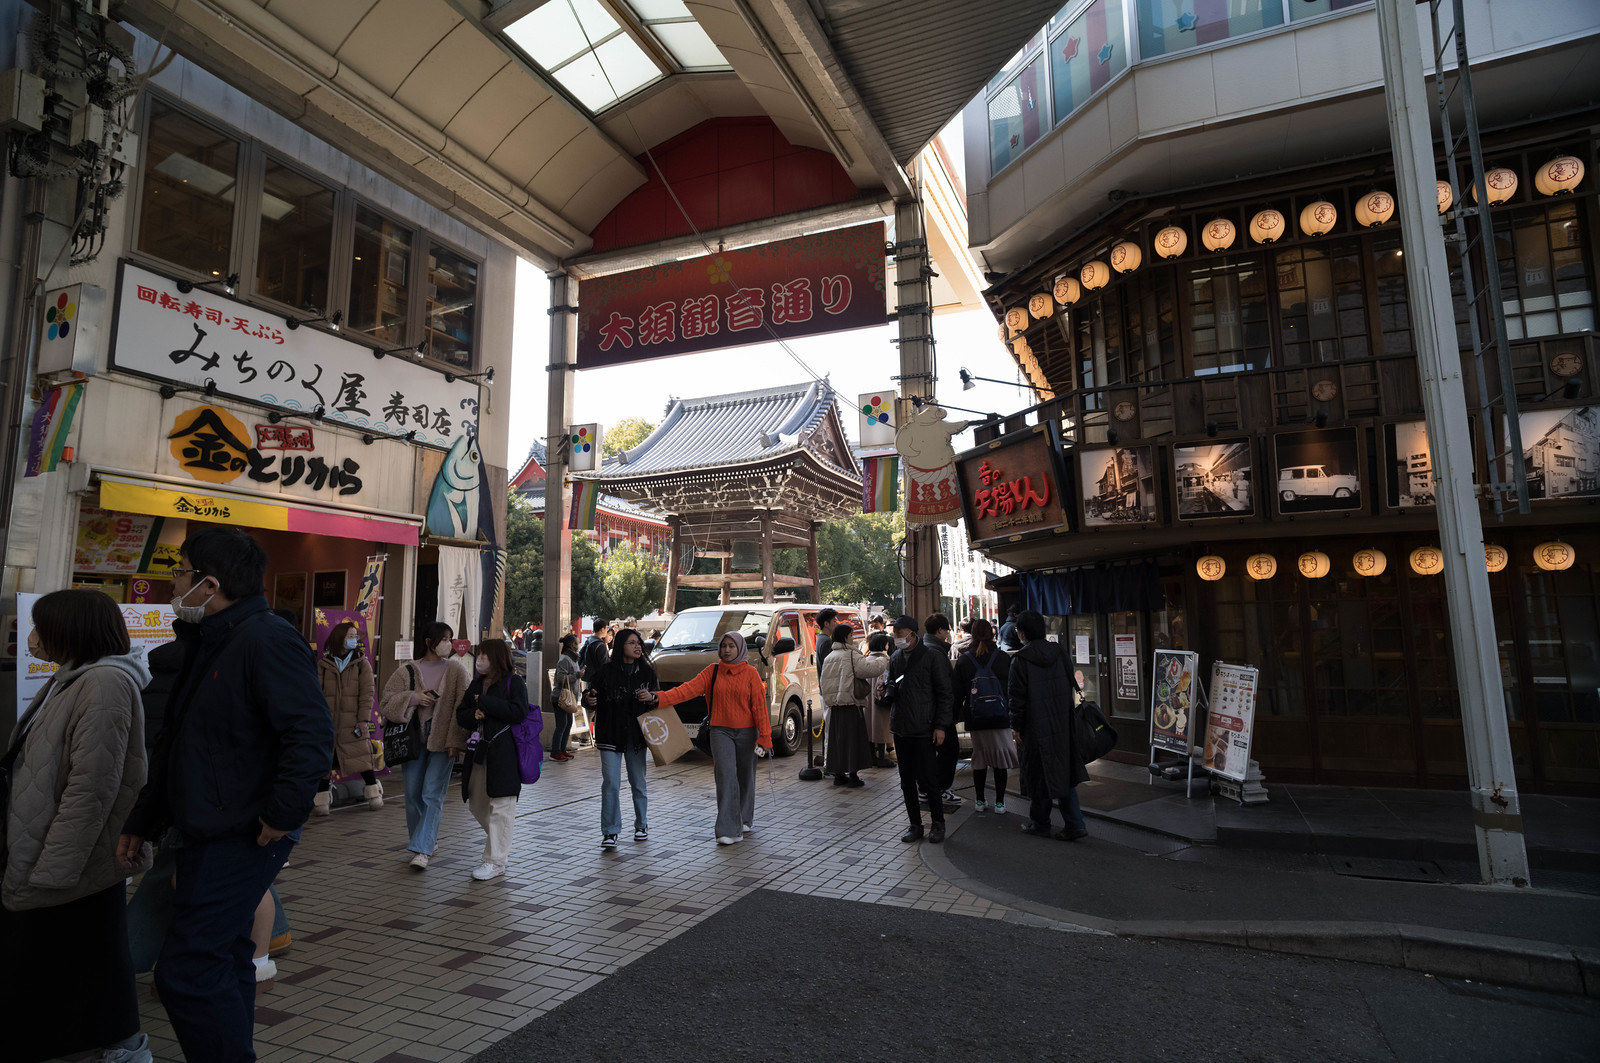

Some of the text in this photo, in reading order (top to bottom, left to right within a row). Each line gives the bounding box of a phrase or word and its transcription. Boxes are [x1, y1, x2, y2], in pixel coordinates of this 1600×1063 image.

[137, 284, 284, 345] 回転寿司・天ぷら
[598, 274, 853, 351] 大須観音通り
[168, 322, 452, 437] みちのく屋 寿司店
[167, 408, 363, 495] 金のとりから
[978, 460, 1002, 486] 昔の
[173, 497, 231, 518] 金のとりから
[974, 471, 1050, 520] 矢場とん
